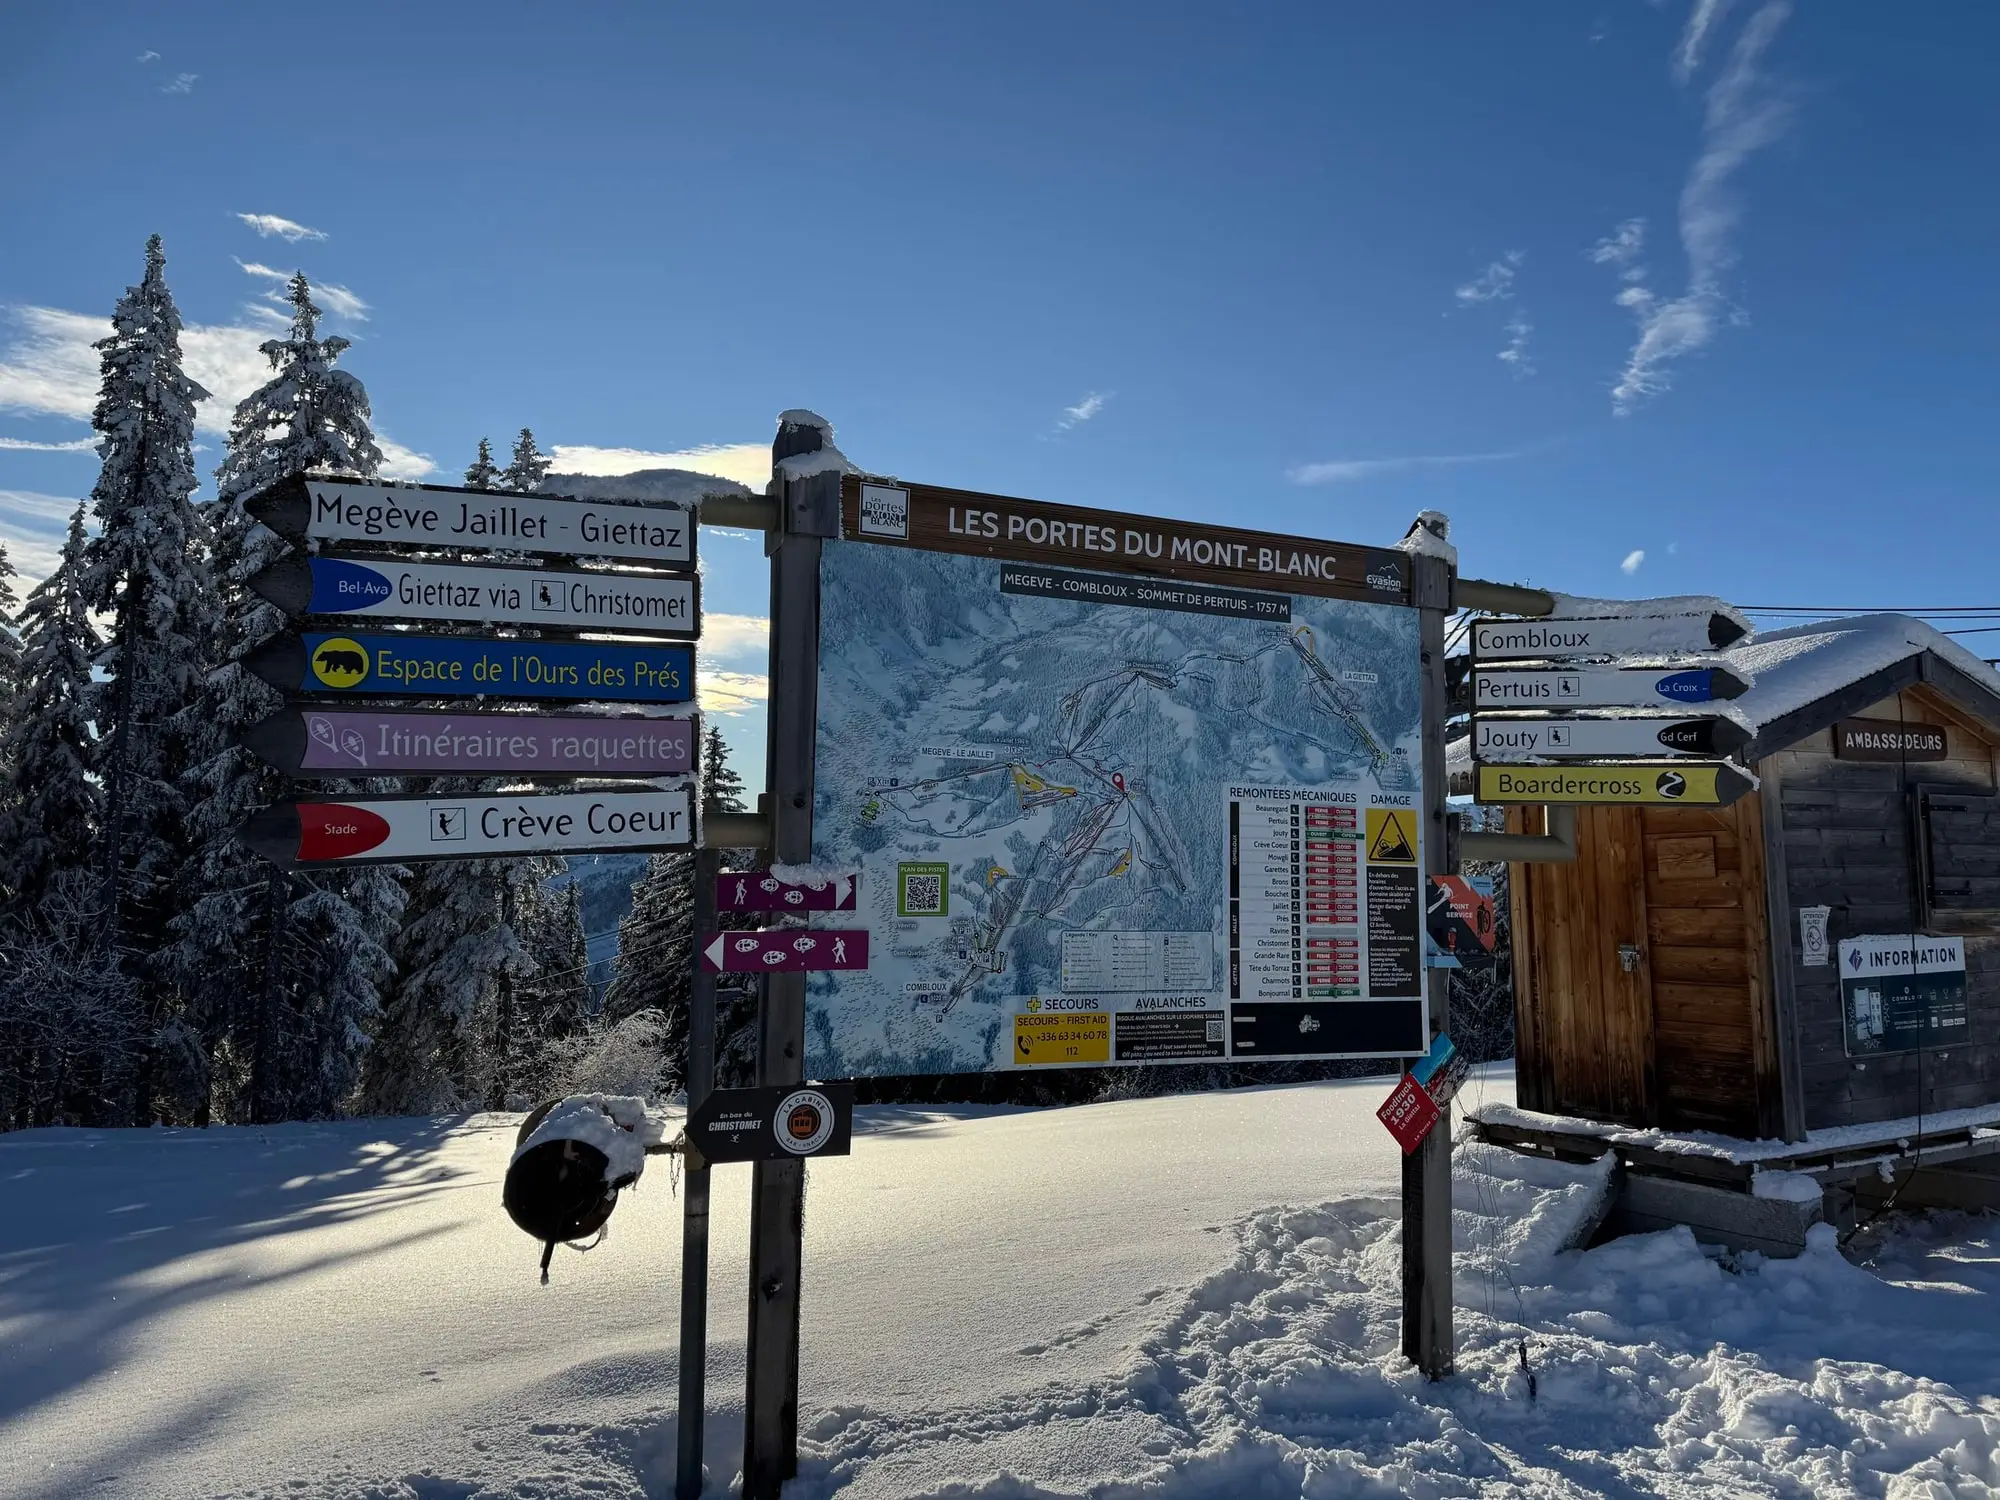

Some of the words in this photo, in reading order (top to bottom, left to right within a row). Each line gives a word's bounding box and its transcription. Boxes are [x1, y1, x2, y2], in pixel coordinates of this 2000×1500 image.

[315, 493, 439, 534] Megève
[450, 504, 548, 539] Jaillet
[580, 513, 683, 549] Giettaz
[871, 517, 903, 529] BLANC
[949, 507, 999, 539] LES
[1008, 515, 1117, 554] PORTES
[1124, 529, 1163, 558] DU
[1170, 536, 1336, 581] MONT-BLANC
[338, 580, 389, 596] Bel-Ava
[1004, 573, 1052, 589] MEGEVE
[1062, 579, 1128, 598] COMBLOUX
[1137, 589, 1184, 604] SOMMET
[1186, 594, 1202, 606] DE
[1204, 596, 1248, 611] PERTUIS
[1256, 602, 1278, 614] 1757
[1279, 604, 1288, 615] M
[398, 574, 480, 609] Giettaz
[489, 584, 521, 610] via
[570, 583, 687, 618] Christomet
[1479, 629, 1590, 649] Combloux
[377, 650, 462, 690] Espace
[473, 654, 503, 683] de
[512, 655, 579, 686] l'Ours
[588, 658, 625, 687] des
[634, 659, 680, 688] Prés
[1478, 678, 1550, 698] Pertuis
[1659, 683, 1669, 692] La
[1673, 682, 1698, 692] Croix
[1479, 728, 1538, 750] Jouty
[1660, 732, 1675, 742] Gd
[1677, 731, 1697, 742] Cerf
[1845, 732, 1943, 750] AMBASSADEURS
[377, 724, 539, 760] Itinéraires
[551, 731, 686, 766] raquettes
[922, 747, 951, 757] MEGEVE
[956, 749, 966, 757] LE
[966, 750, 994, 759] JAILLET
[1499, 774, 1642, 795] Boardercross
[1230, 787, 1291, 800] REMONTÉES
[1293, 788, 1357, 803] MÉCANIQUES
[1371, 794, 1411, 806] DAMAGE
[1256, 804, 1288, 814] Beauregard
[481, 806, 573, 840] Crève
[588, 803, 683, 835] Coeur
[1268, 817, 1288, 825] Pertuis
[324, 823, 358, 837] Stade
[1273, 829, 1288, 838] Jouty
[1272, 841, 1288, 849] Coeur
[1268, 853, 1288, 862] Mowgli
[1264, 865, 1288, 873] Garettes
[1265, 889, 1289, 898] Bouchet
[1272, 902, 1289, 910] Jaillet
[1269, 927, 1289, 935] Ravine
[1257, 939, 1289, 947] Christomet
[1254, 951, 1277, 959] Grande
[1870, 948, 1956, 967] INFORMATION
[1264, 964, 1272, 972] du
[906, 983, 947, 991] COMBLOUX
[1045, 999, 1099, 1010] SECOURS
[1136, 997, 1206, 1009] AVALANCHES
[1017, 1017, 1059, 1026] SECOURS
[1067, 1016, 1090, 1025] FIRST
[1092, 1015, 1107, 1024] AID
[1037, 1032, 1056, 1041] +336
[1058, 1032, 1069, 1041] 63
[1071, 1031, 1081, 1040] 34
[1083, 1031, 1095, 1040] 60
[1096, 1031, 1107, 1039] 78
[1066, 1046, 1078, 1056] 112
[783, 1103, 793, 1114] LA
[795, 1096, 826, 1111] CABINE
[1381, 1081, 1413, 1120] Foodtruck
[1391, 1094, 1416, 1126] 1930
[708, 1119, 762, 1132] CHRISTOMET
